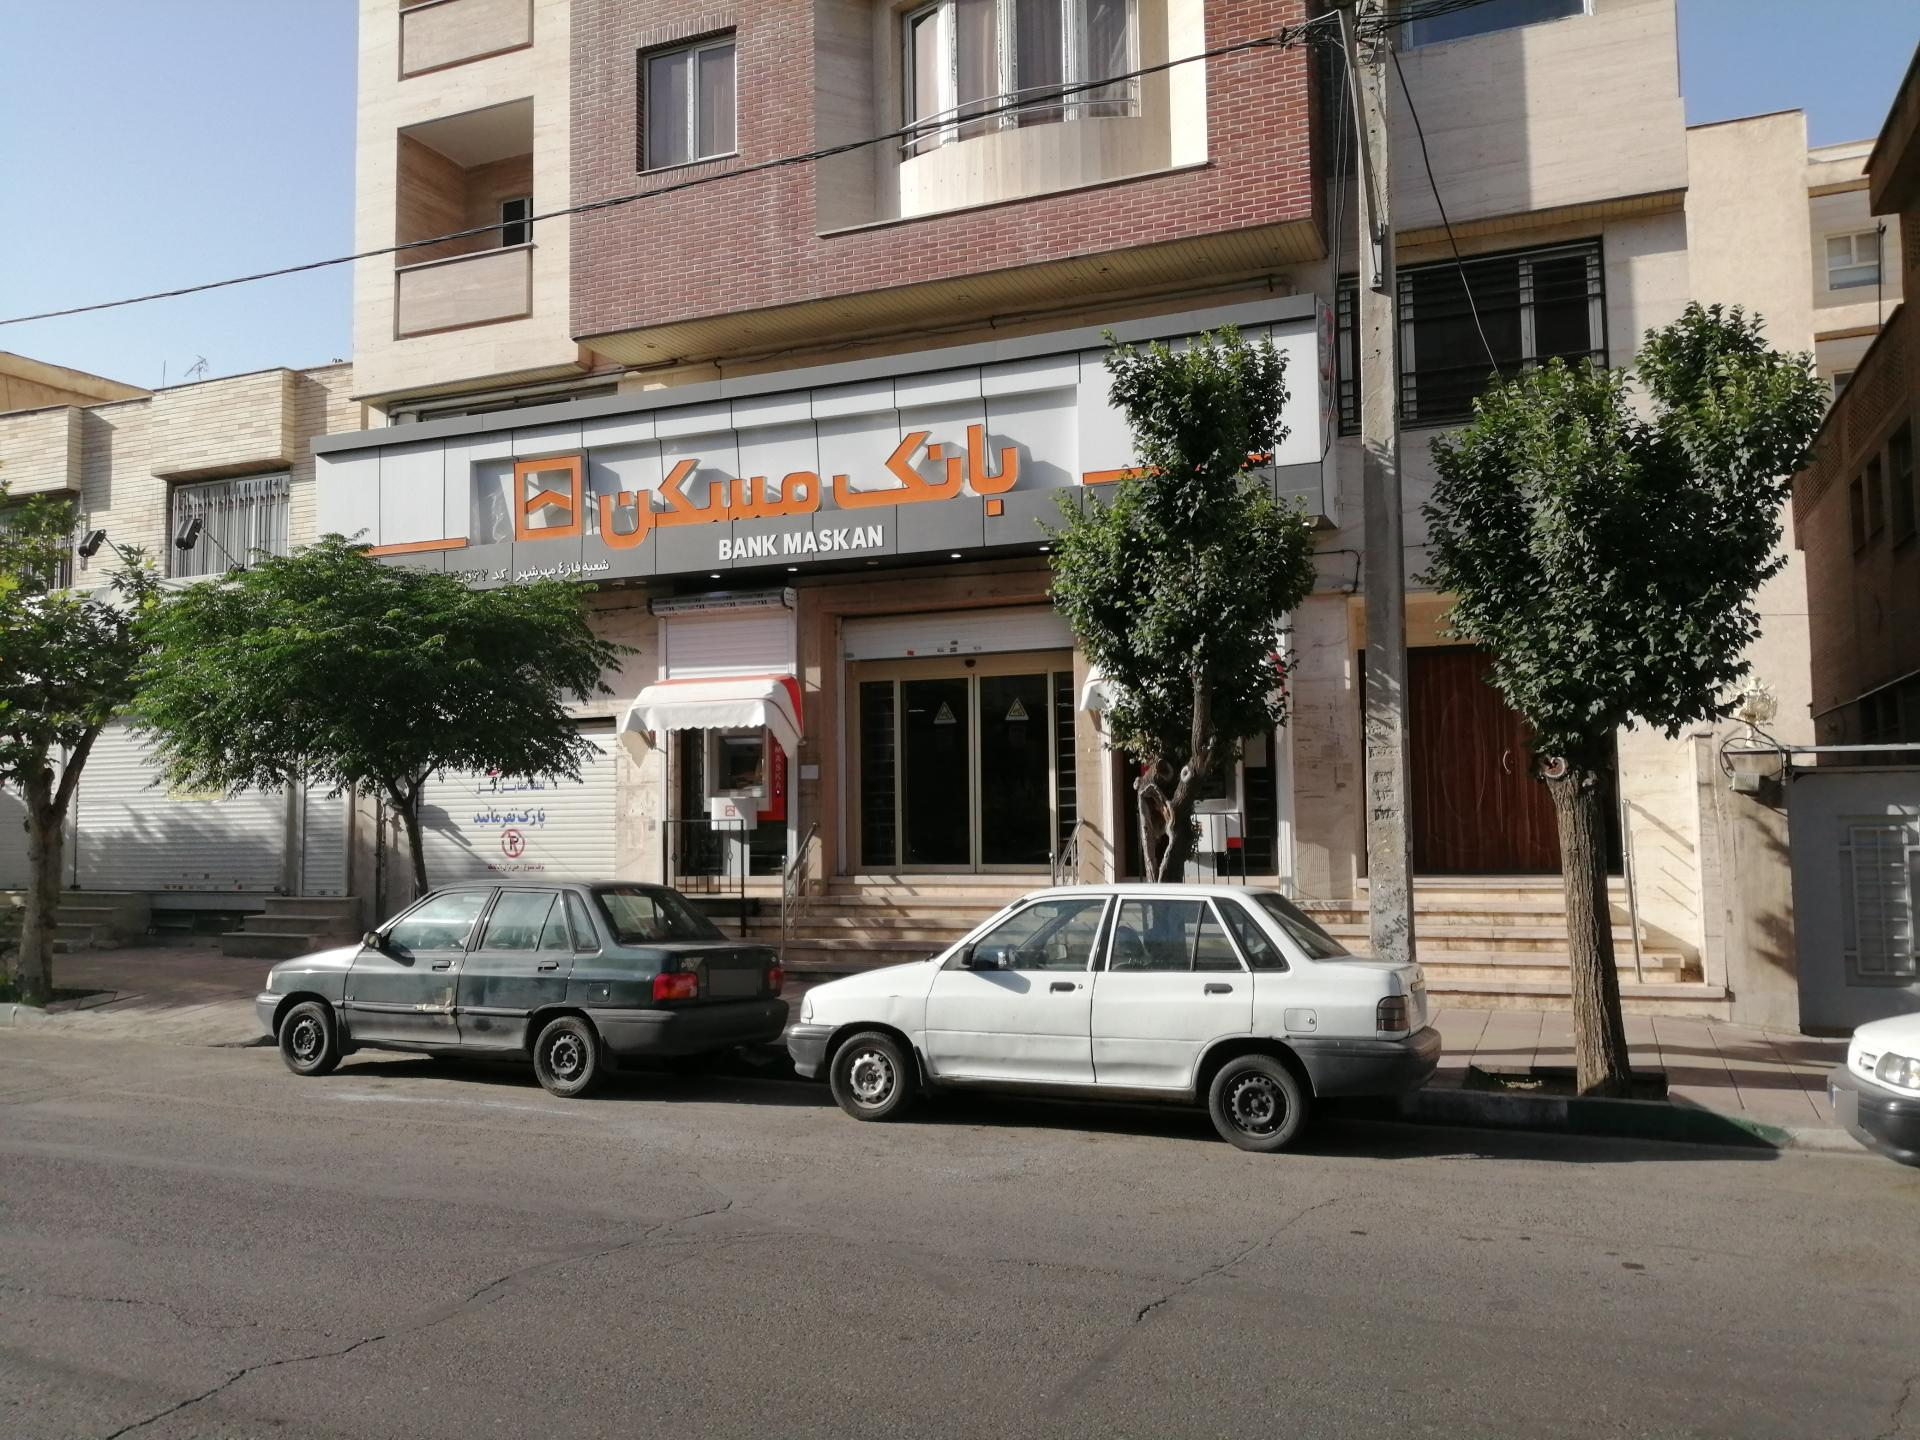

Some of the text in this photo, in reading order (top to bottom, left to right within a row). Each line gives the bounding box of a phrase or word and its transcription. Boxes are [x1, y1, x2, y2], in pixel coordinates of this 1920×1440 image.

[599, 423, 1018, 550] بانک مسکن
[718, 524, 885, 561] BANK MASKAN
[516, 565, 556, 582] مهرشهر
[583, 559, 611, 577] شعبه
[517, 807, 546, 829] پارک
